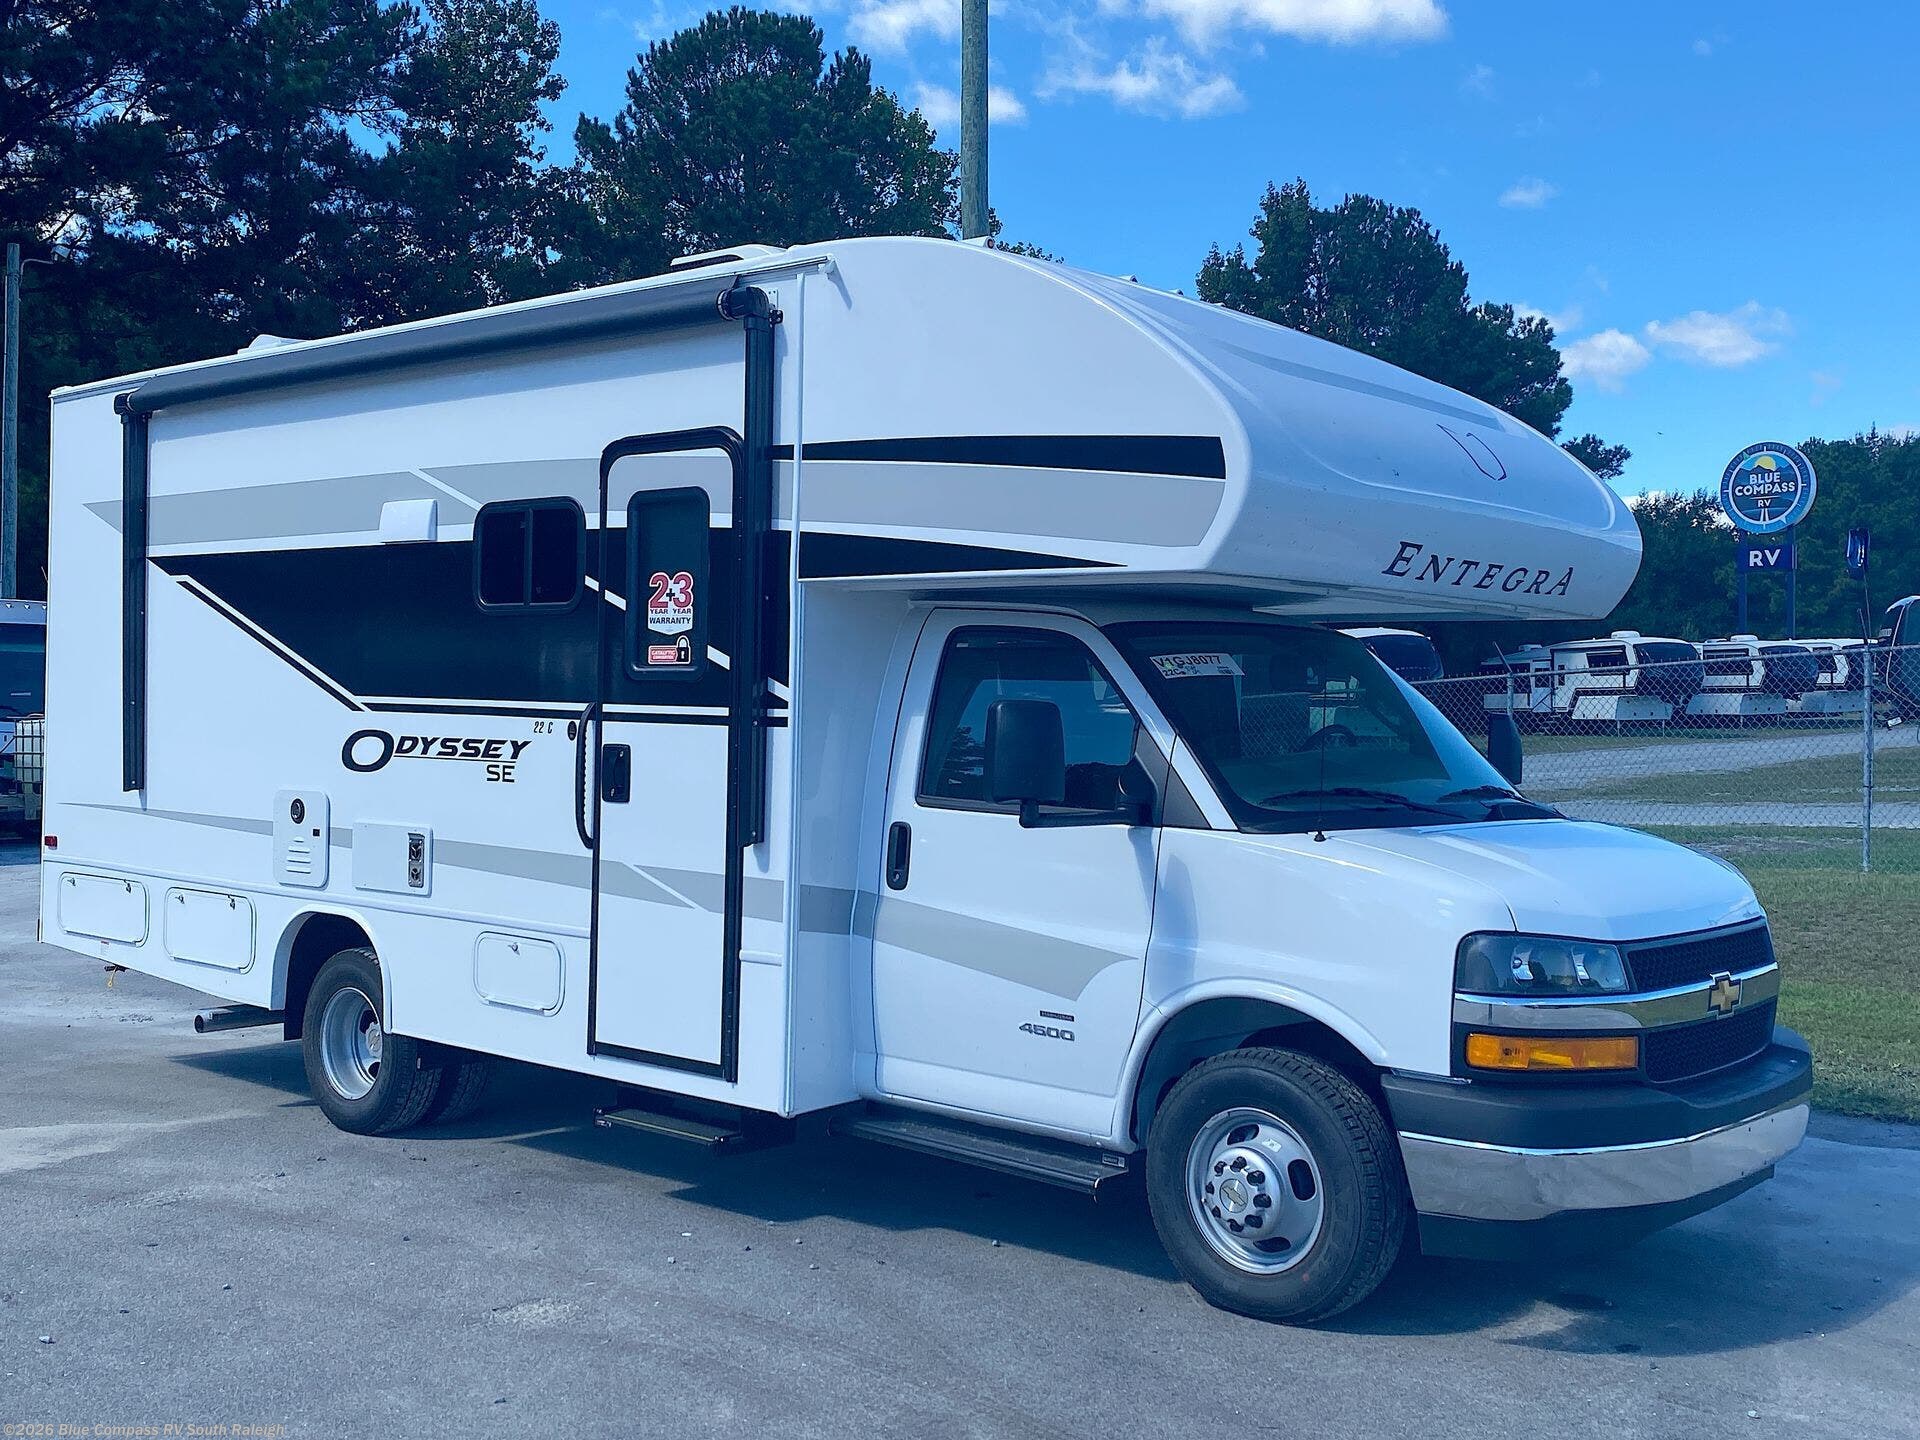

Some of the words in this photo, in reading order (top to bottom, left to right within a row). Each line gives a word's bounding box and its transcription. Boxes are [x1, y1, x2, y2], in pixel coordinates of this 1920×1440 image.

[1749, 472, 1781, 484] BLUE
[1734, 482, 1796, 496] COMPASS
[1757, 500, 1771, 508] RV
[1749, 549, 1781, 567] RV
[1381, 541, 1574, 596] ENTEGRA
[649, 617, 691, 625] WARRANTY
[533, 721, 545, 734] 22
[341, 729, 532, 772] ODYSSEY
[486, 764, 515, 783] SE
[1019, 1023, 1075, 1041] 4500
